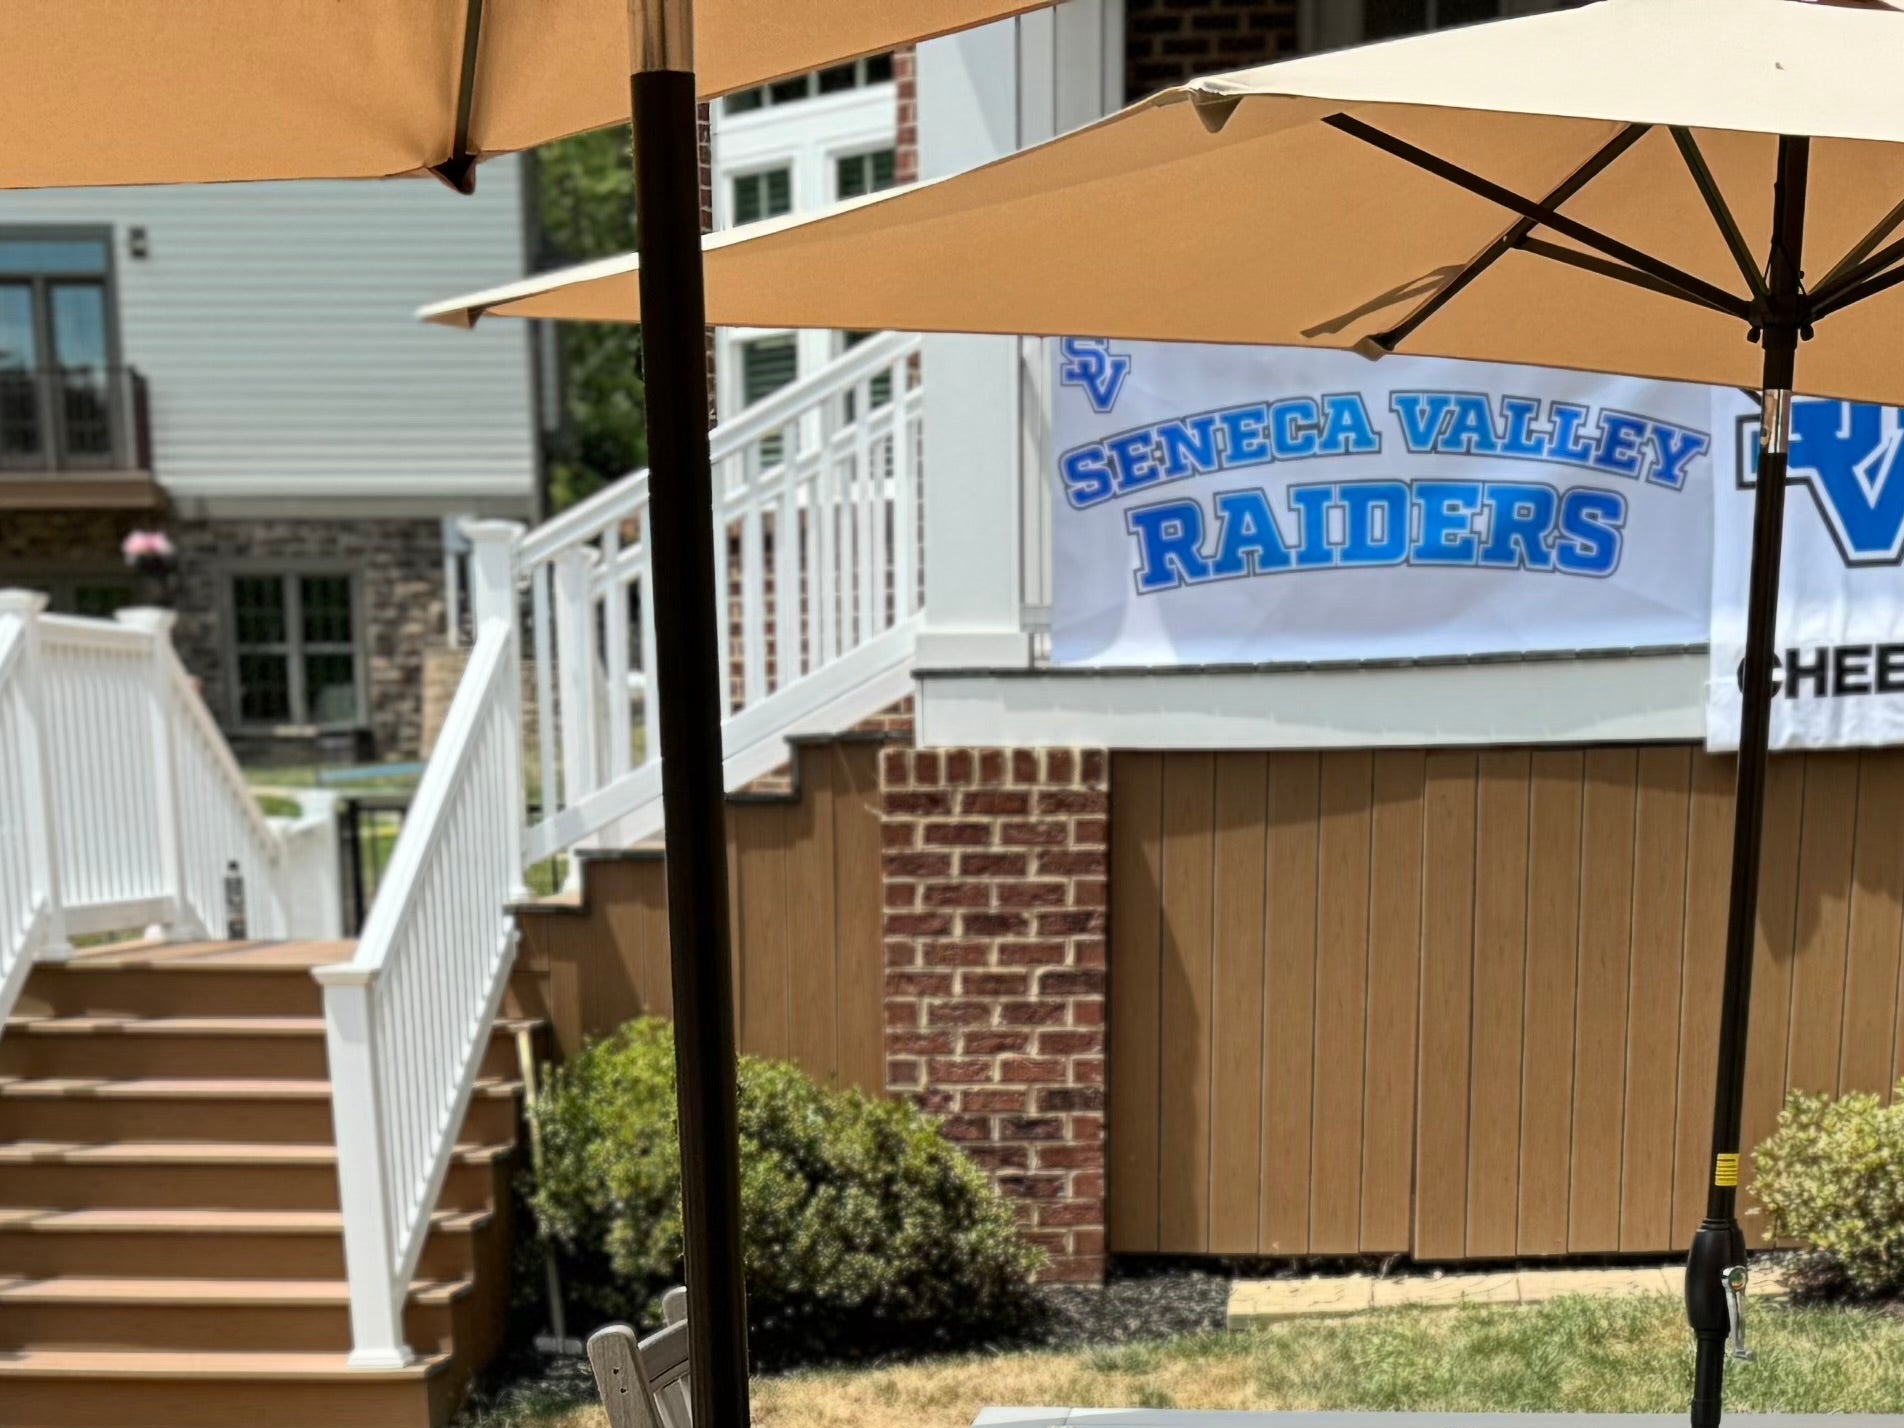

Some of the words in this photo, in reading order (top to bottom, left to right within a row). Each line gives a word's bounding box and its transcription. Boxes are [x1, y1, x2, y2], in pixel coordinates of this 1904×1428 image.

[1059, 392, 1381, 510] SENECA
[1389, 390, 1711, 491] VALLEY
[1125, 478, 1628, 595] RAIDERS
